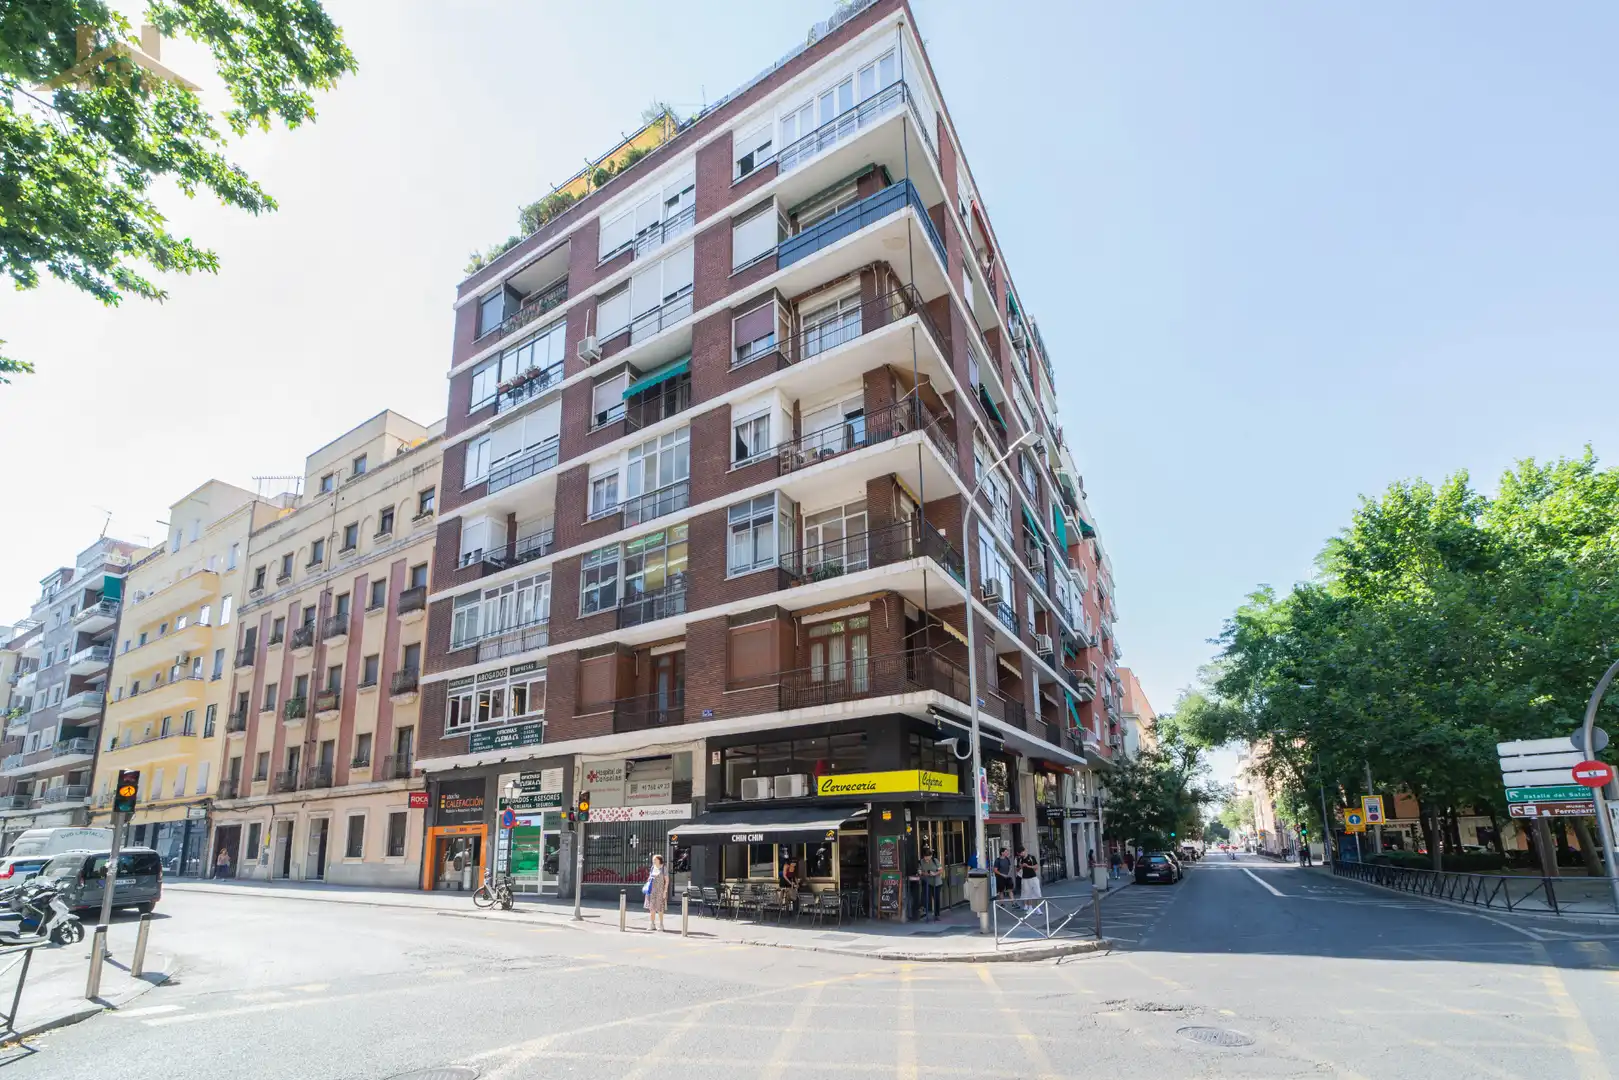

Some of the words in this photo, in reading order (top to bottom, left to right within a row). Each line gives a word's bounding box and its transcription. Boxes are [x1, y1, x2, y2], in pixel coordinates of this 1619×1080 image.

[512, 663, 534, 673] EMPRESAS
[478, 669, 507, 682] ABOGADOS
[534, 794, 560, 802] ASESORES
[731, 834, 747, 842] CHIN
[748, 833, 763, 842] CHIN
